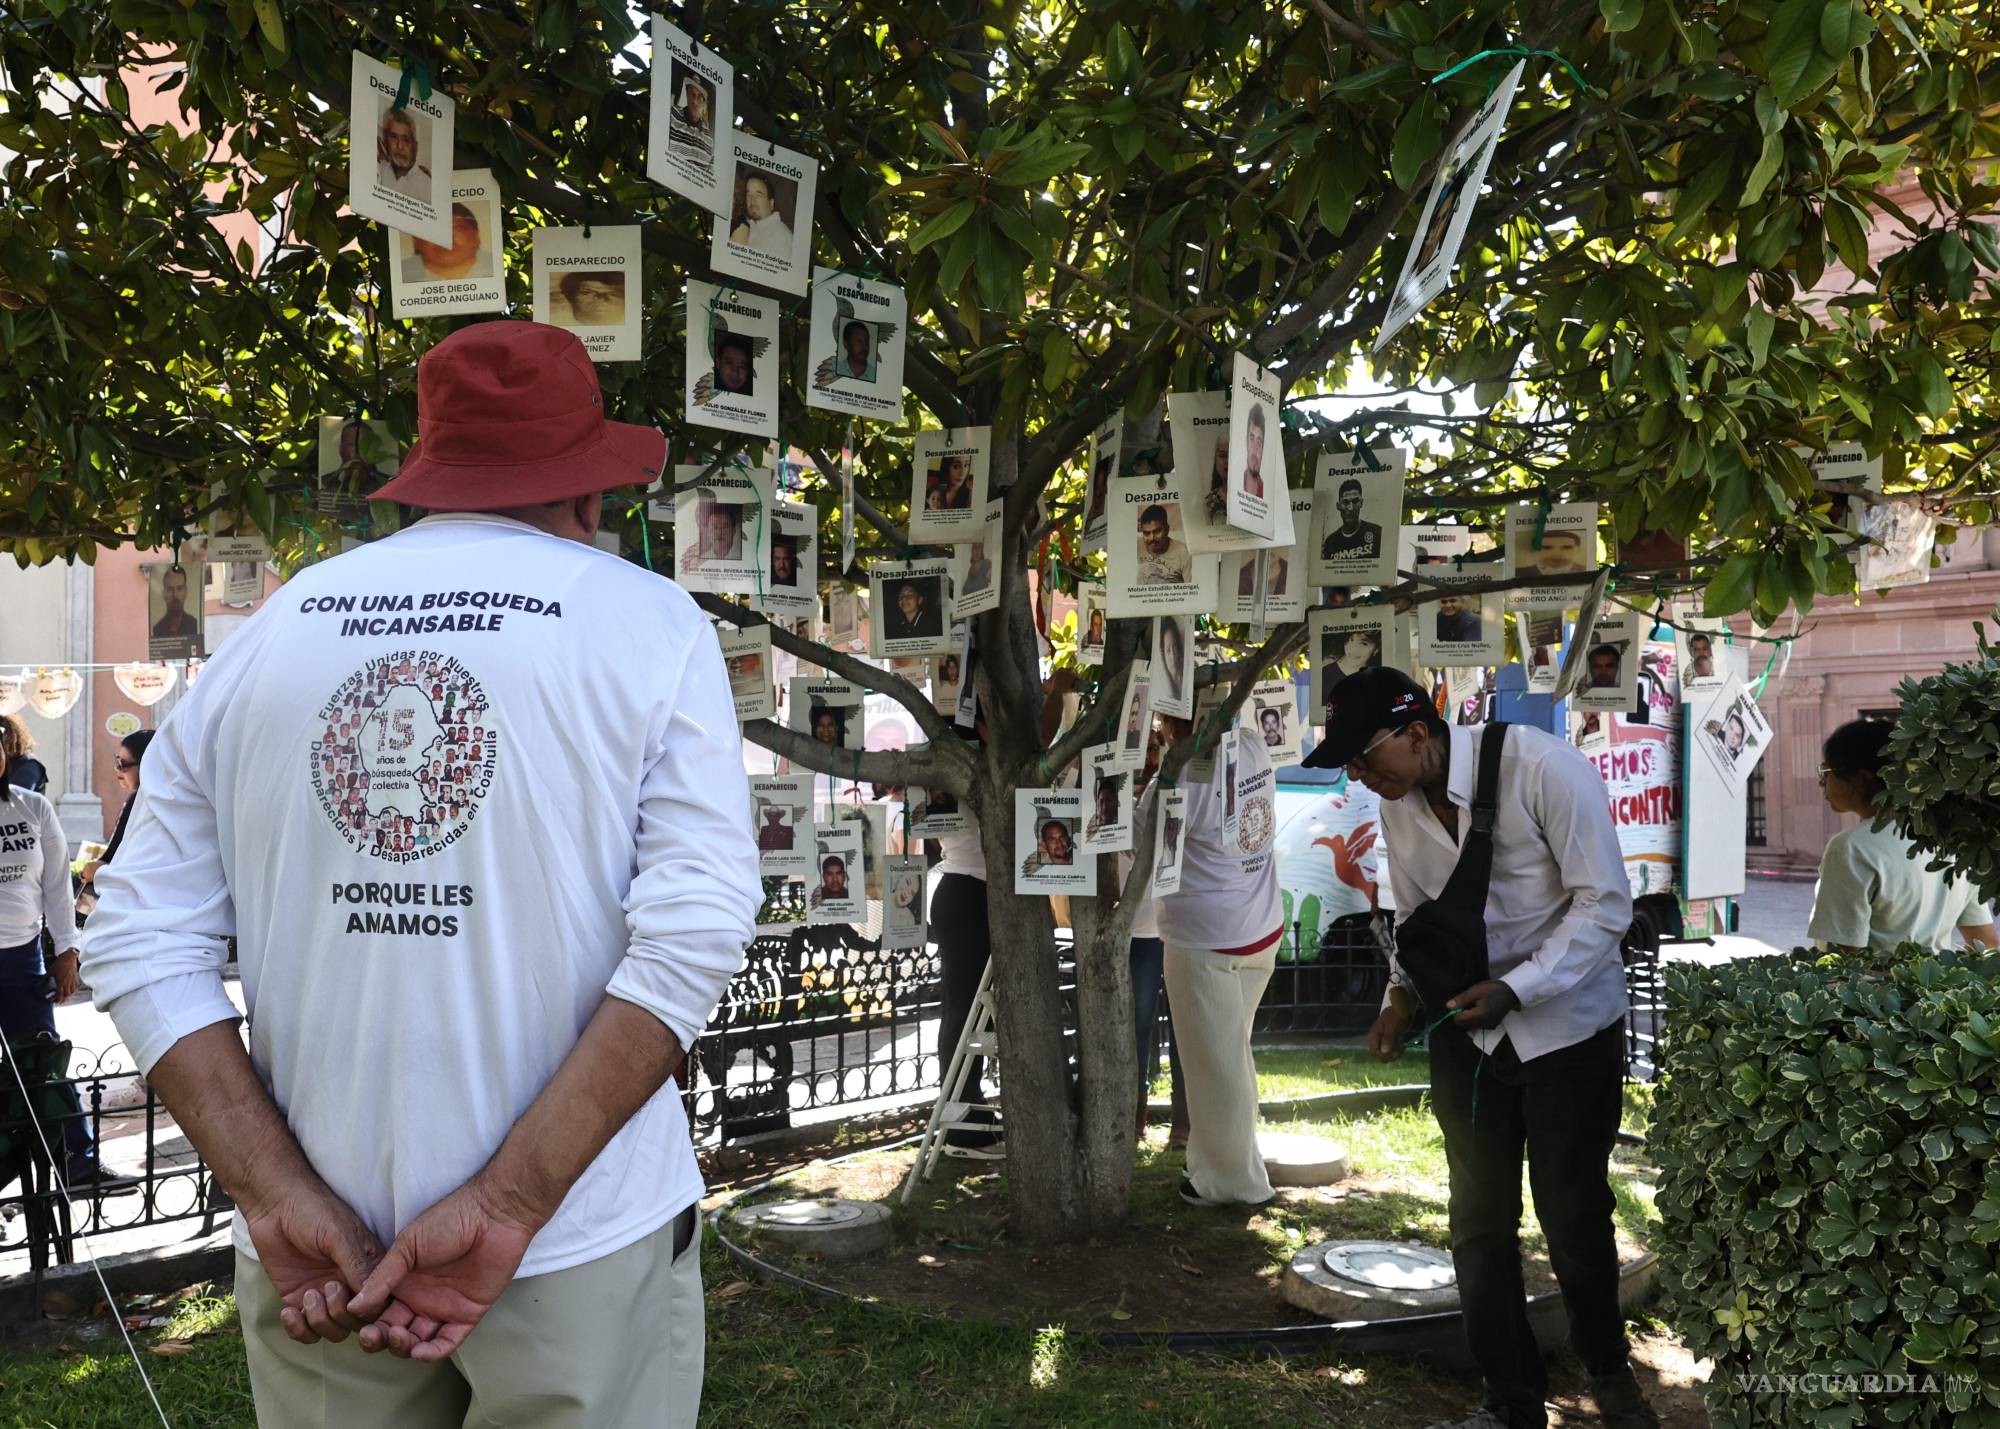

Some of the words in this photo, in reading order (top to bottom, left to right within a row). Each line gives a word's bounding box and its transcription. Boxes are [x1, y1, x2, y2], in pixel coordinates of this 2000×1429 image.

[665, 38, 724, 86] Desaparecido
[369, 75, 443, 119] Desarecido
[733, 145, 803, 180] Desaparecido
[545, 256, 625, 266] DESAPARECIDO
[420, 285, 445, 295] JOSE
[447, 283, 477, 294] DIEGO
[400, 295, 447, 307] CORDERO
[448, 291, 499, 304] ANGUIANO
[837, 286, 891, 307] DESAPARECIDO
[584, 335, 616, 343] JAVIER
[1242, 376, 1275, 406] Desaparecido
[747, 409, 767, 418] FLORES
[925, 448, 979, 458] Desaparecidas
[1515, 515, 1583, 526] DESAARECIDO
[875, 566, 947, 579] Desaparecido
[1430, 573, 1493, 584] Desaparecido
[300, 596, 357, 613] CON
[360, 595, 413, 612] UNA
[419, 591, 562, 618] BUSQUEDA
[340, 614, 504, 636] INCANSABLE
[1322, 621, 1382, 632] Desaparecida
[319, 669, 363, 721] Fuerzas
[365, 650, 416, 671] Unidas
[420, 650, 444, 662] por
[445, 656, 490, 713] Nuestros
[371, 708, 415, 752] 15
[376, 755, 395, 765] años
[396, 755, 406, 765] de
[474, 730, 497, 799] Coahuila
[371, 768, 412, 780] búsqueda
[372, 781, 410, 791] colectiva
[754, 783, 798, 792] DESAPARECIDO
[311, 741, 355, 844] Desaparecidos
[356, 842, 366, 853] y
[370, 821, 468, 866] Desaparecidas
[467, 802, 479, 821] en
[1033, 797, 1079, 805] DESAPARECIDO
[817, 829, 851, 838] DESAPARECIDO
[332, 882, 426, 907] PORQUE
[431, 884, 474, 907] LES
[345, 912, 459, 937] AMAMOS
